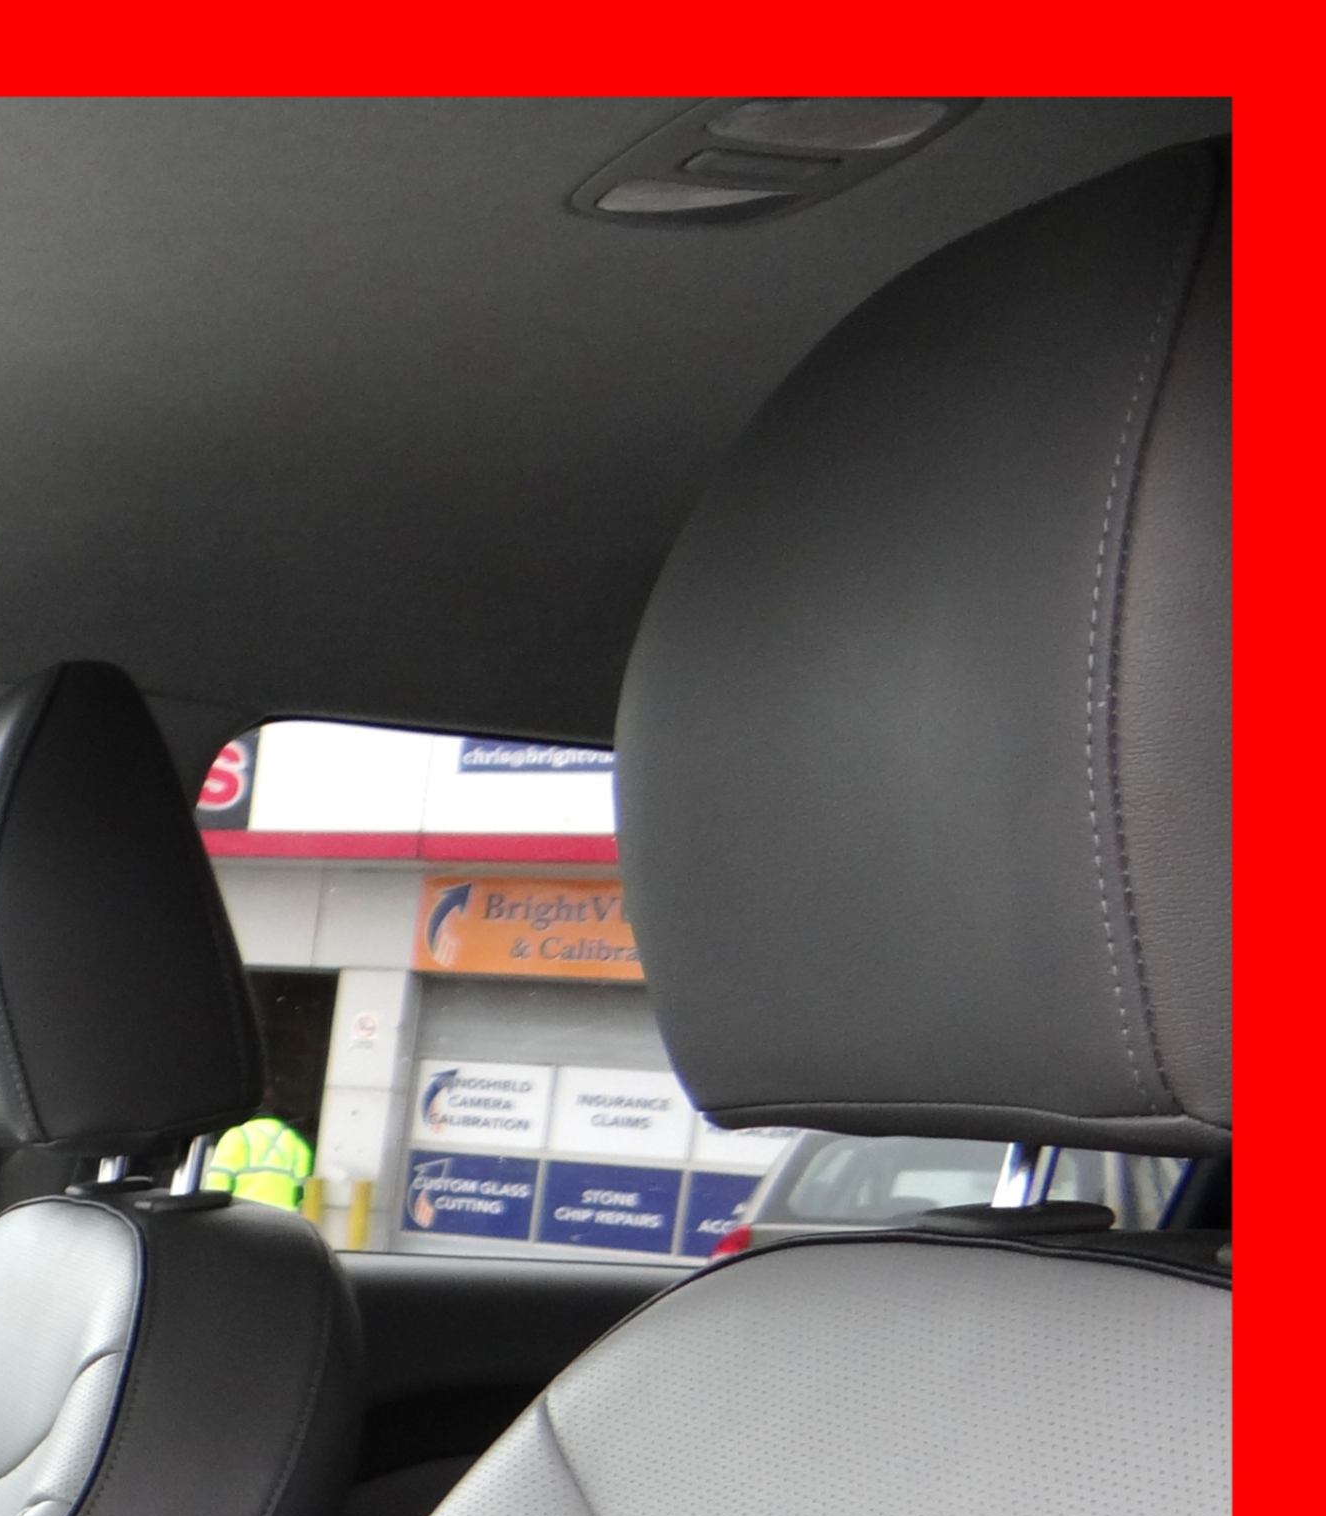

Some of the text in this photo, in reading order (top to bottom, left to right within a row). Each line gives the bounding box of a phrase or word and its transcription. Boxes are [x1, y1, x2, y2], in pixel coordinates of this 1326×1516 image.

[483, 893, 626, 931] BrightV
[510, 937, 531, 960] &
[448, 1095, 514, 1112] CAMERA
[576, 1093, 672, 1112] INSURANCE
[428, 1114, 530, 1132] CALIBRATION
[590, 1113, 652, 1130] CLAIMS
[412, 1175, 532, 1199] CUSTOM GLASS
[435, 1197, 503, 1215] CUTTING
[581, 1189, 641, 1207] STONE
[554, 1206, 663, 1229] CHIP REPAIRS
